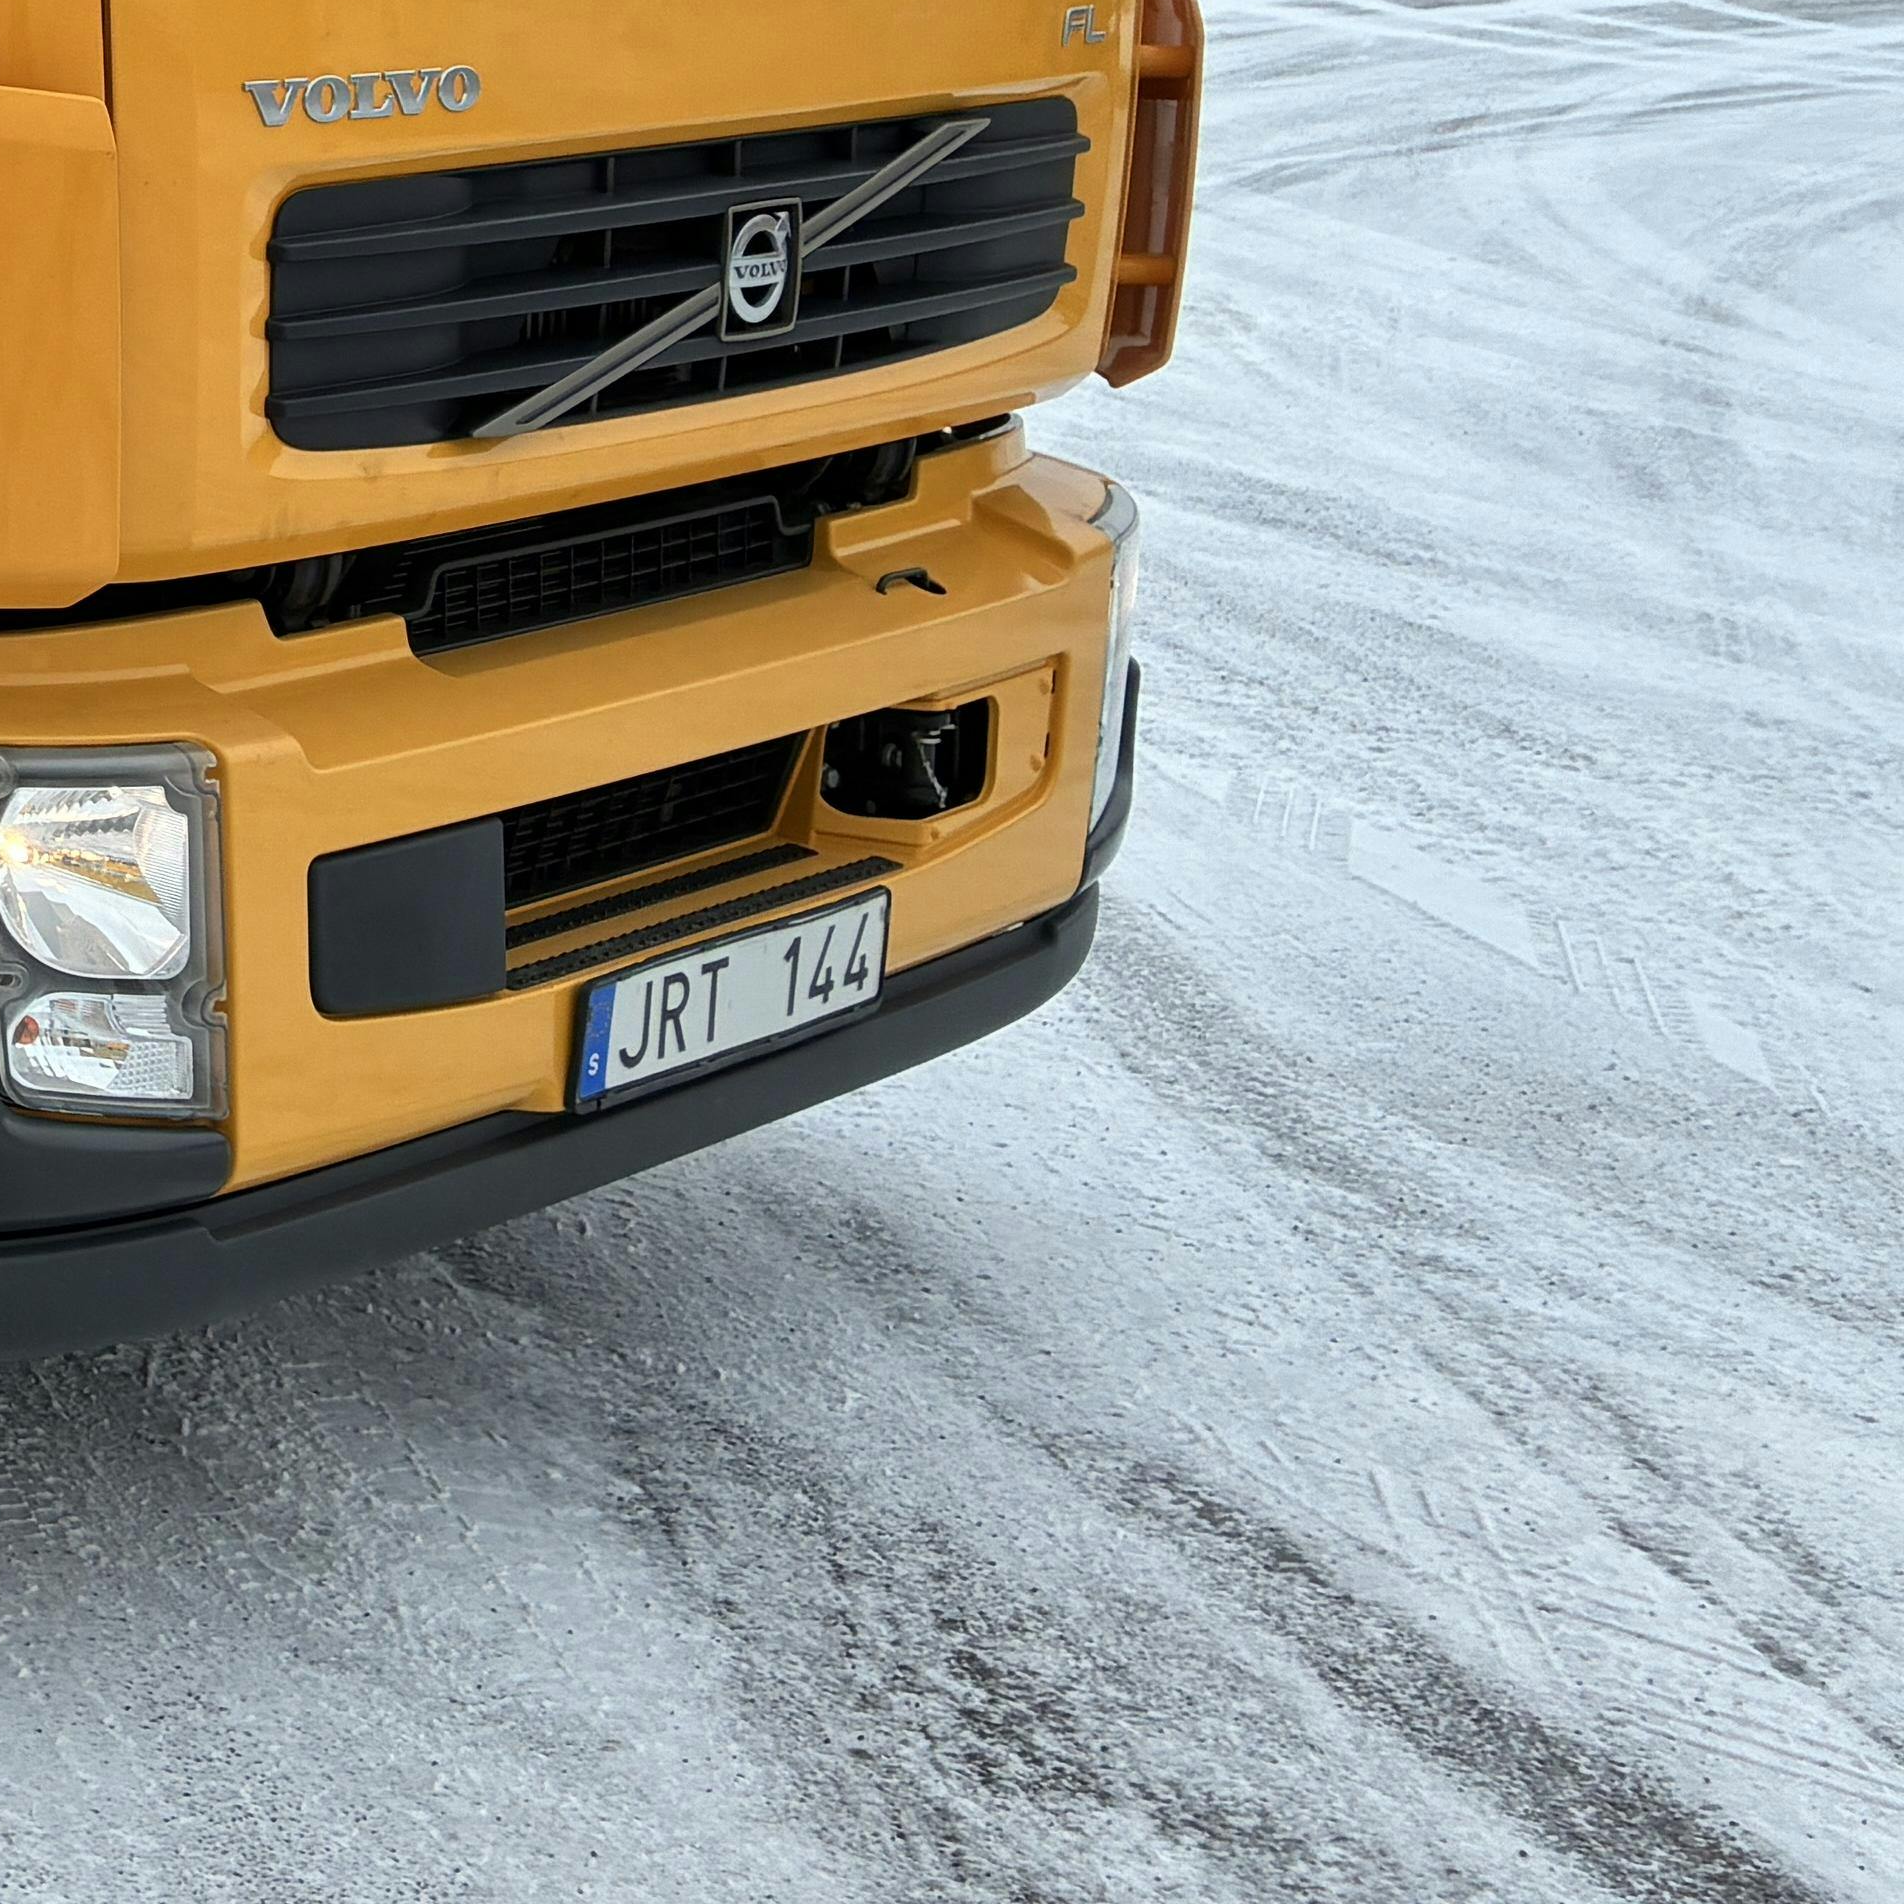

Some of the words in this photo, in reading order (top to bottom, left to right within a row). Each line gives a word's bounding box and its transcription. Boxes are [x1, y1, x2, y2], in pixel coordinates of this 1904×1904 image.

[1061, 4, 1107, 47] FL
[242, 64, 482, 127] VOLVO
[618, 955, 731, 1070] JRT
[782, 911, 870, 1017] 144
[586, 1051, 601, 1077] S
